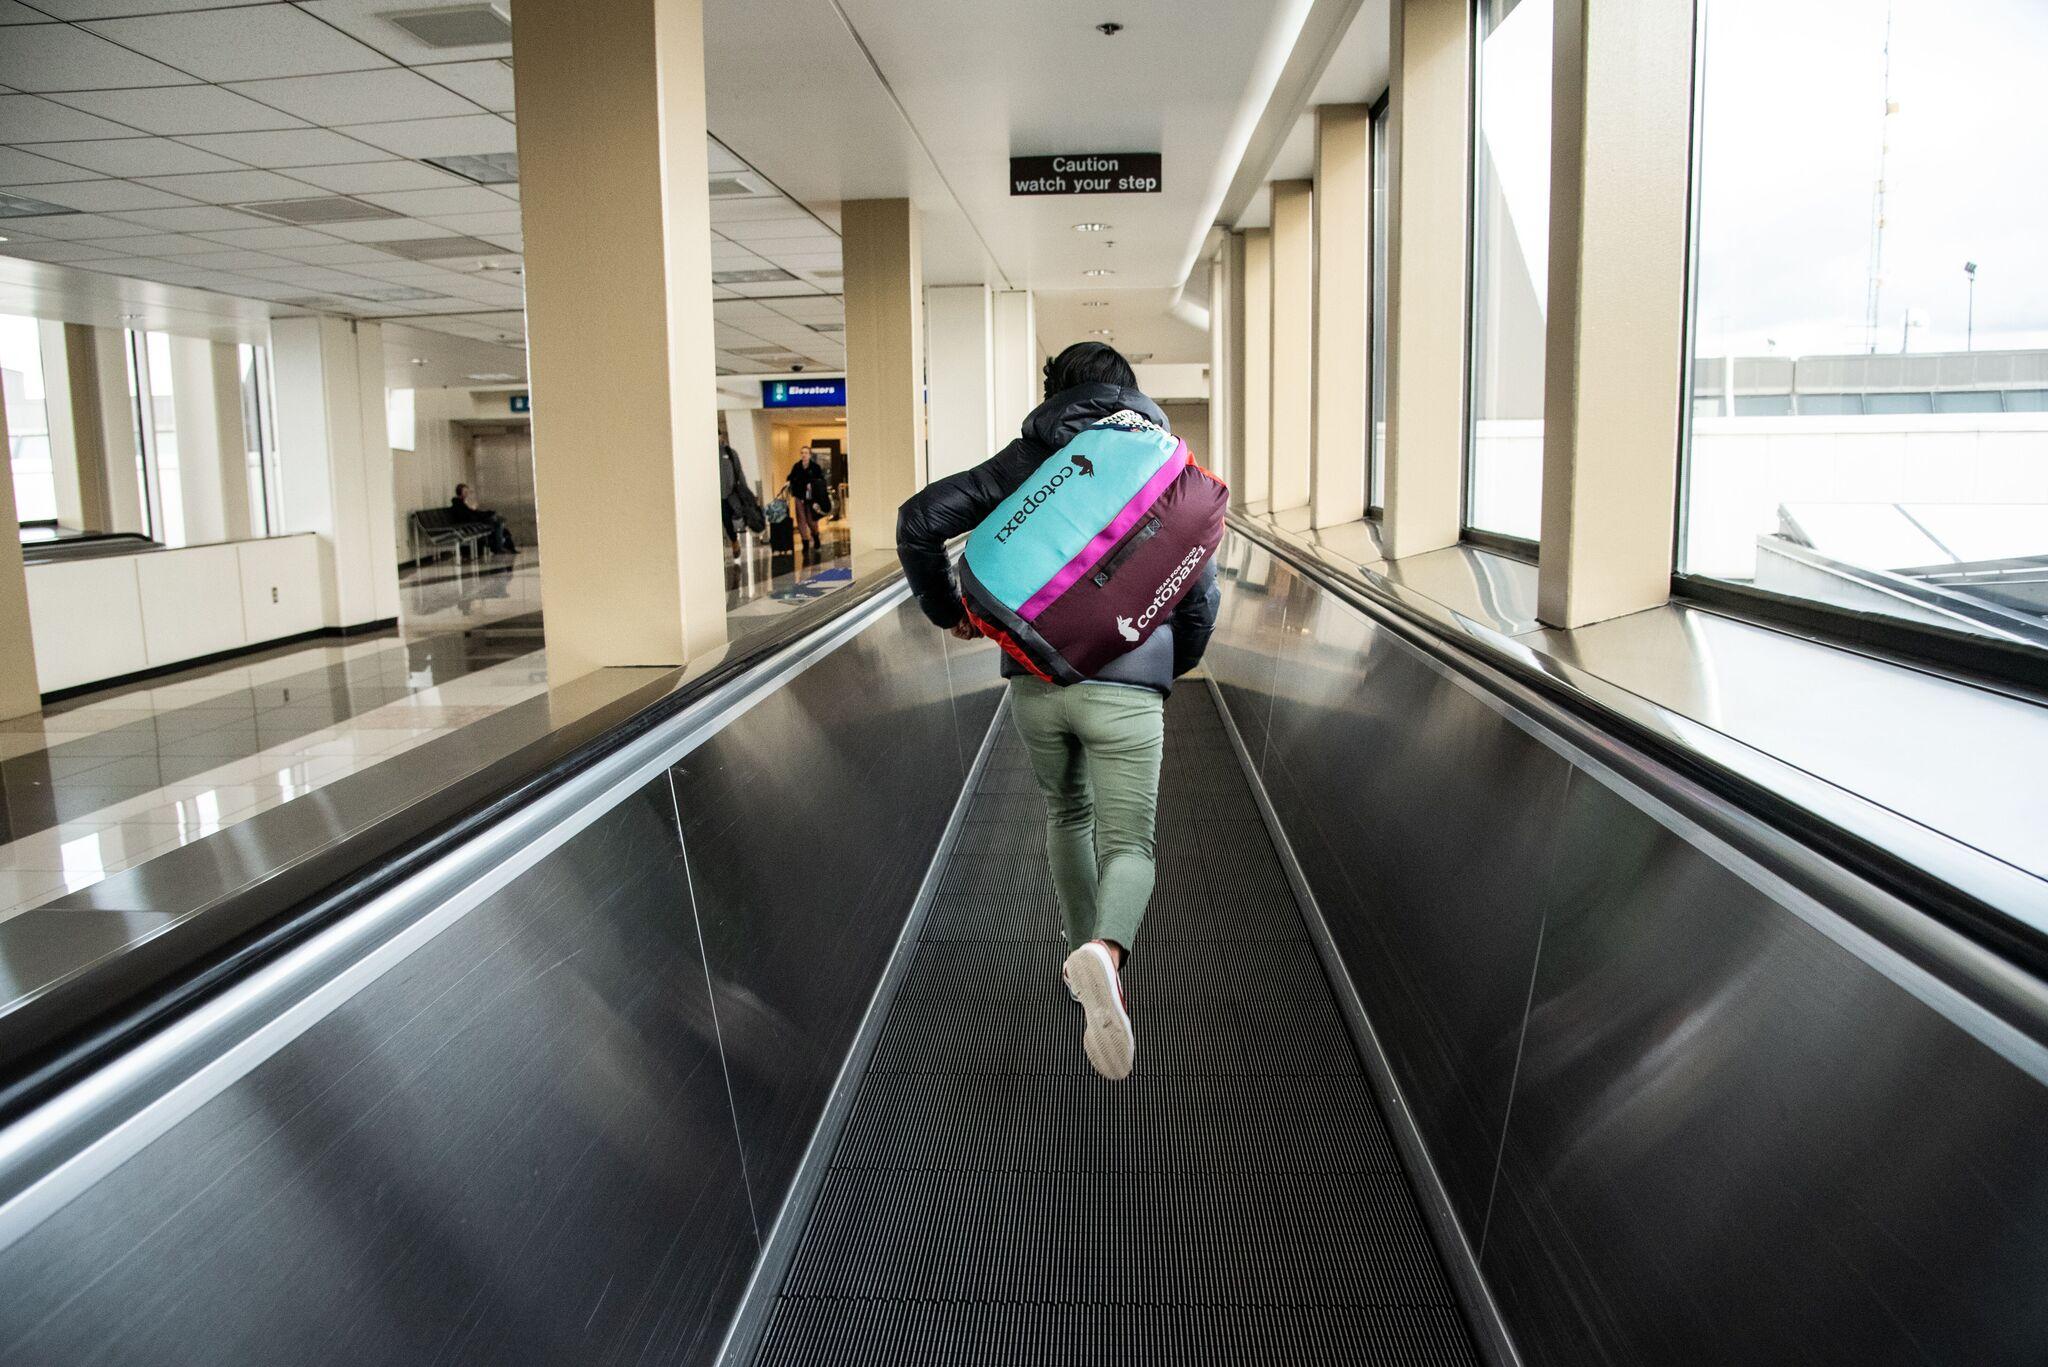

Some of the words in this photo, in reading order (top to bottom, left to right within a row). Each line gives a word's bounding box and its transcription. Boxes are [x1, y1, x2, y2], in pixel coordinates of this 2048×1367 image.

[1053, 157, 1118, 172] Caution
[1016, 177, 1066, 192] watch
[1073, 178, 1111, 193] your
[1118, 175, 1157, 191] step
[788, 386, 835, 395] Elevators
[994, 466, 1073, 544] cotopaxi
[1137, 545, 1207, 629] cotopaxi
[1155, 578, 1171, 595] GEAR
[1170, 565, 1182, 579] FOR
[1181, 546, 1197, 565] GOOD
